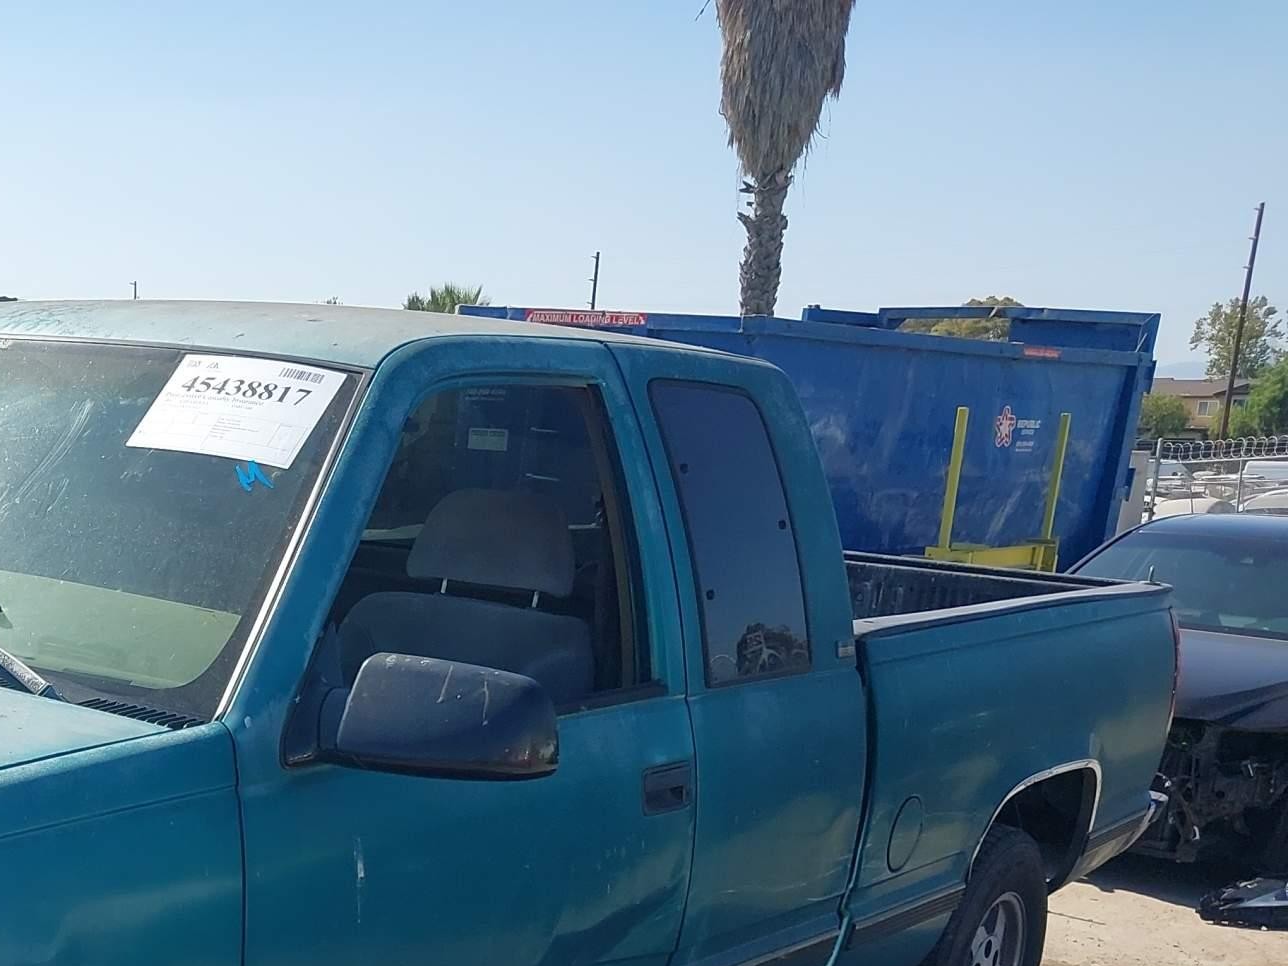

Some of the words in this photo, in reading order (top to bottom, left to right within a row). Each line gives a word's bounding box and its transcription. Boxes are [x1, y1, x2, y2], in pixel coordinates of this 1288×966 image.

[531, 312, 571, 323] MAXIMUM
[573, 313, 611, 324] LOADING
[612, 315, 640, 325] LEVEL
[181, 375, 313, 406] 45438817
